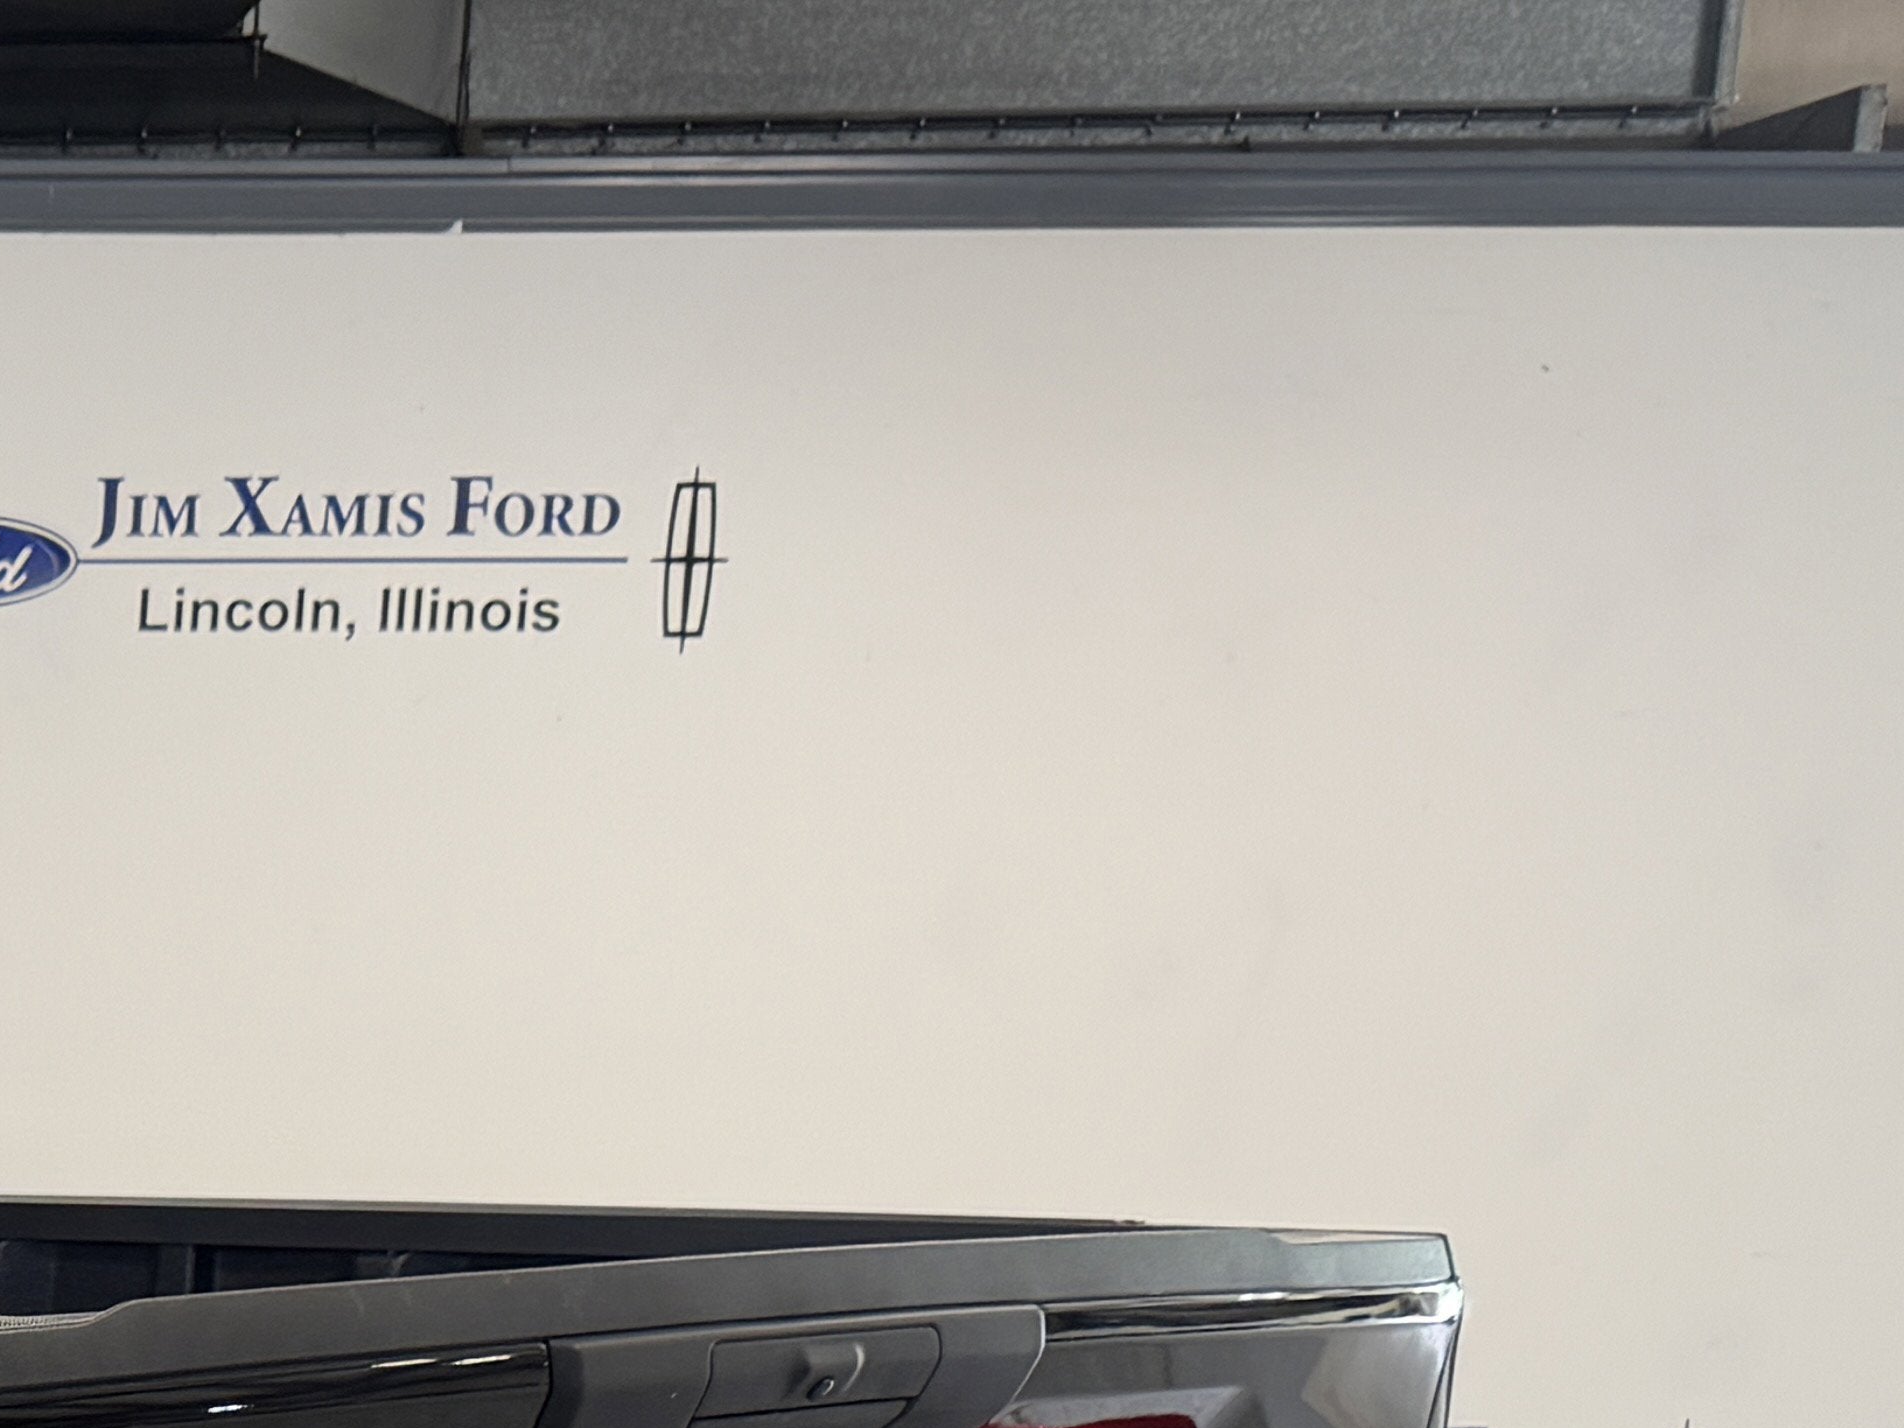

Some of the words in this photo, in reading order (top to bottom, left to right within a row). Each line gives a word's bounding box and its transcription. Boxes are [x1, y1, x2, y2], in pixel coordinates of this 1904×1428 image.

[92, 476, 201, 549] JIM
[218, 476, 426, 538] XAMIS
[447, 475, 622, 538] FORD
[137, 587, 356, 641] Lincoln,
[379, 587, 561, 634] Illinois
